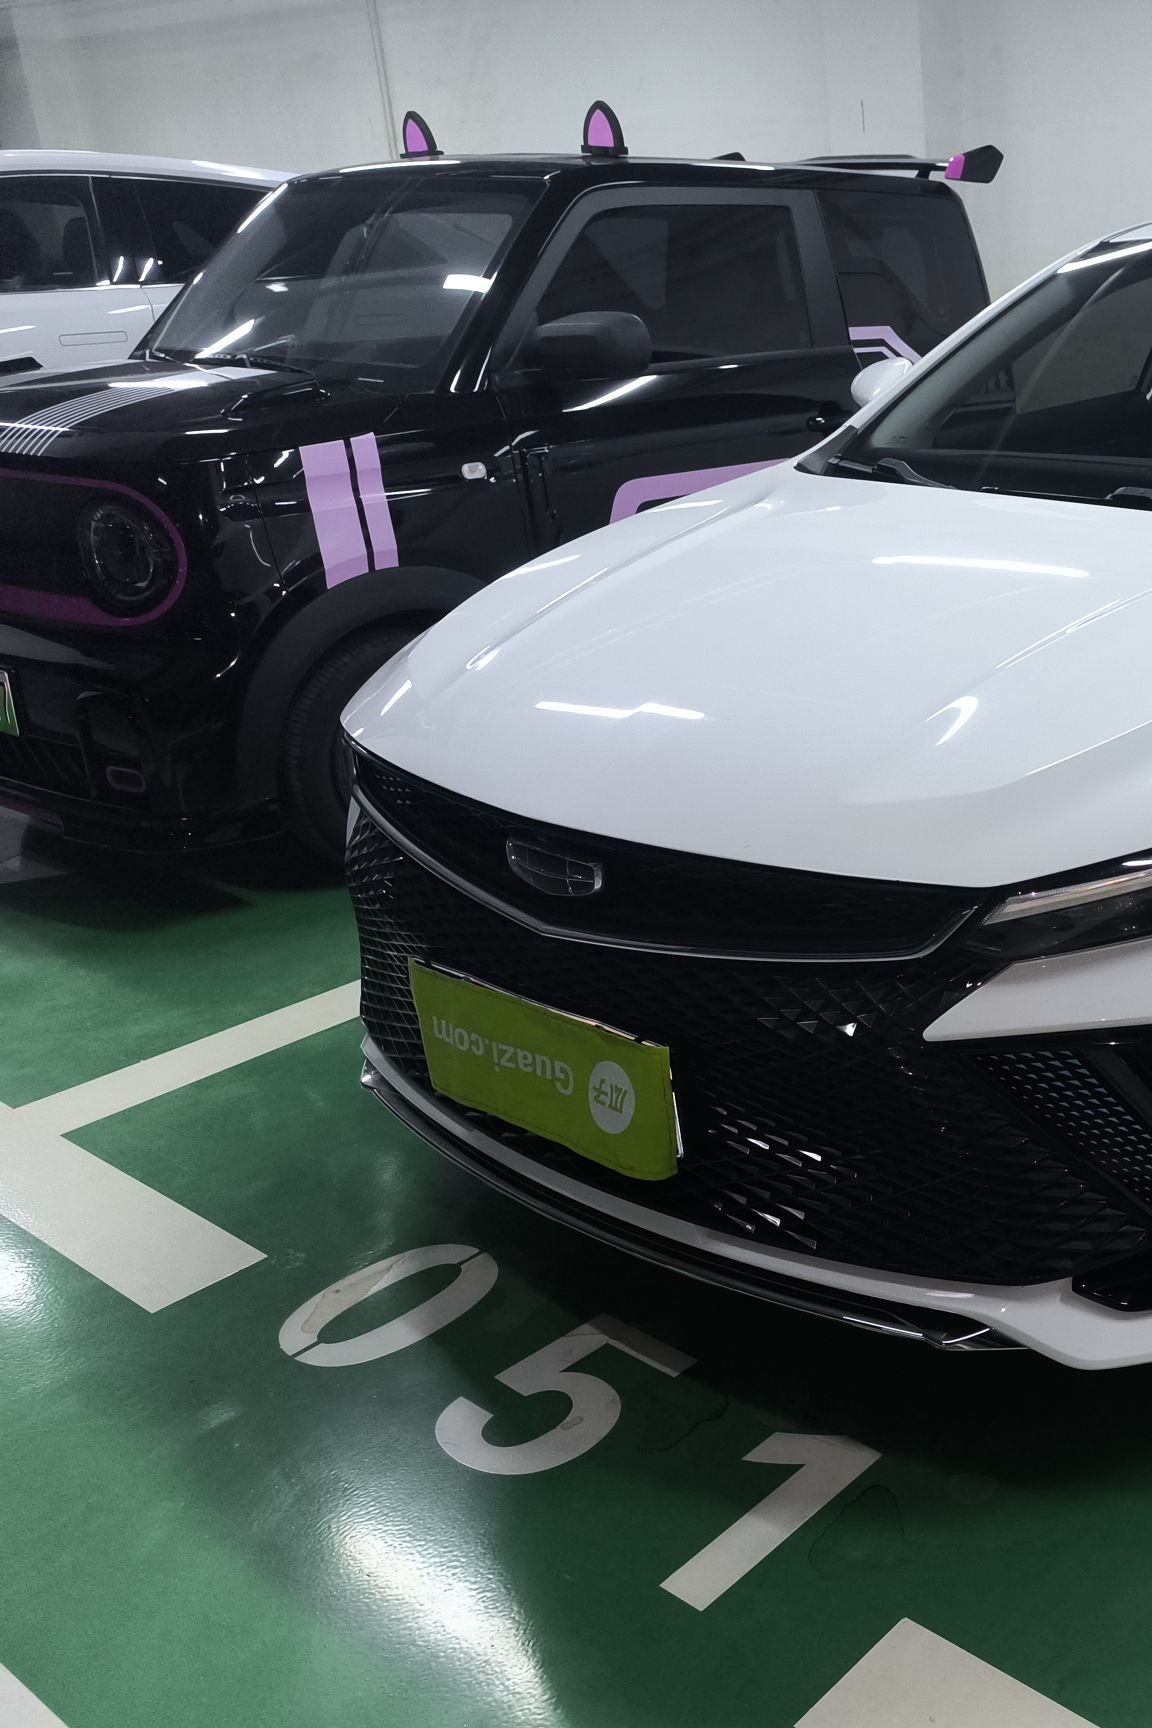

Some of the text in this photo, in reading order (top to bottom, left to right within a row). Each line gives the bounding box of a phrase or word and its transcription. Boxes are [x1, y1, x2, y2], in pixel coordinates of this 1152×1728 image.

[431, 1015, 628, 1114] 瓜子 Guazi.com
[278, 1243, 883, 1611] 051
